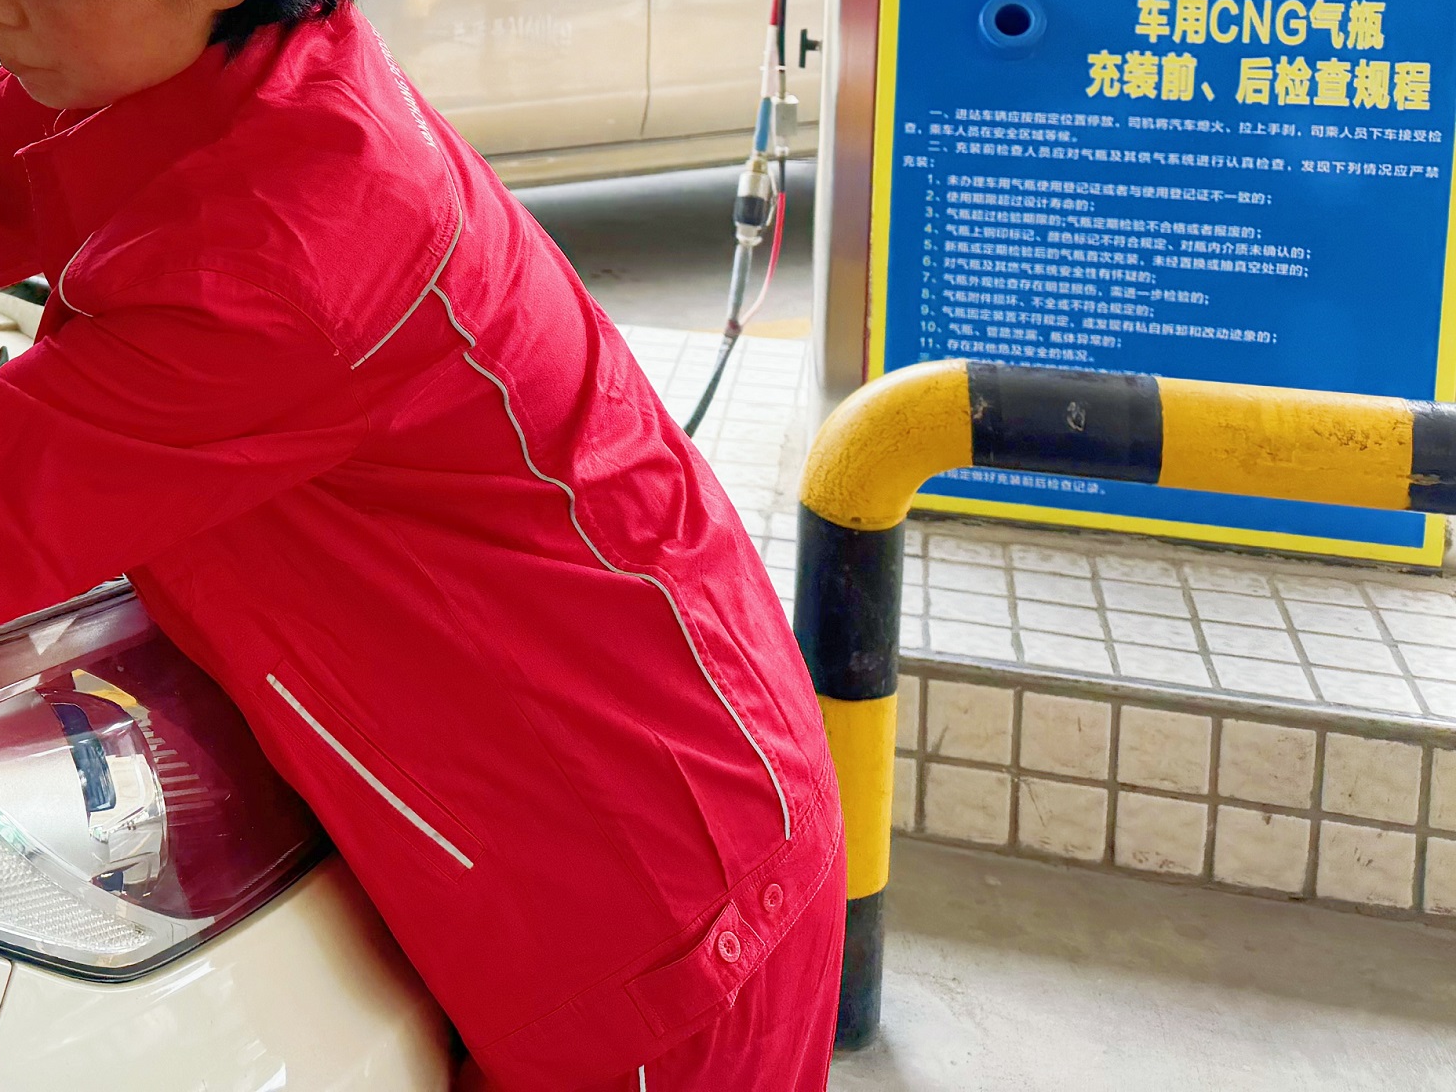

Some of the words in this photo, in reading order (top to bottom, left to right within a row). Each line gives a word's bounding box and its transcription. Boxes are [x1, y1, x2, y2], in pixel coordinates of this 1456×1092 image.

[1086, 48, 1432, 111] 充装前、后检查规程
